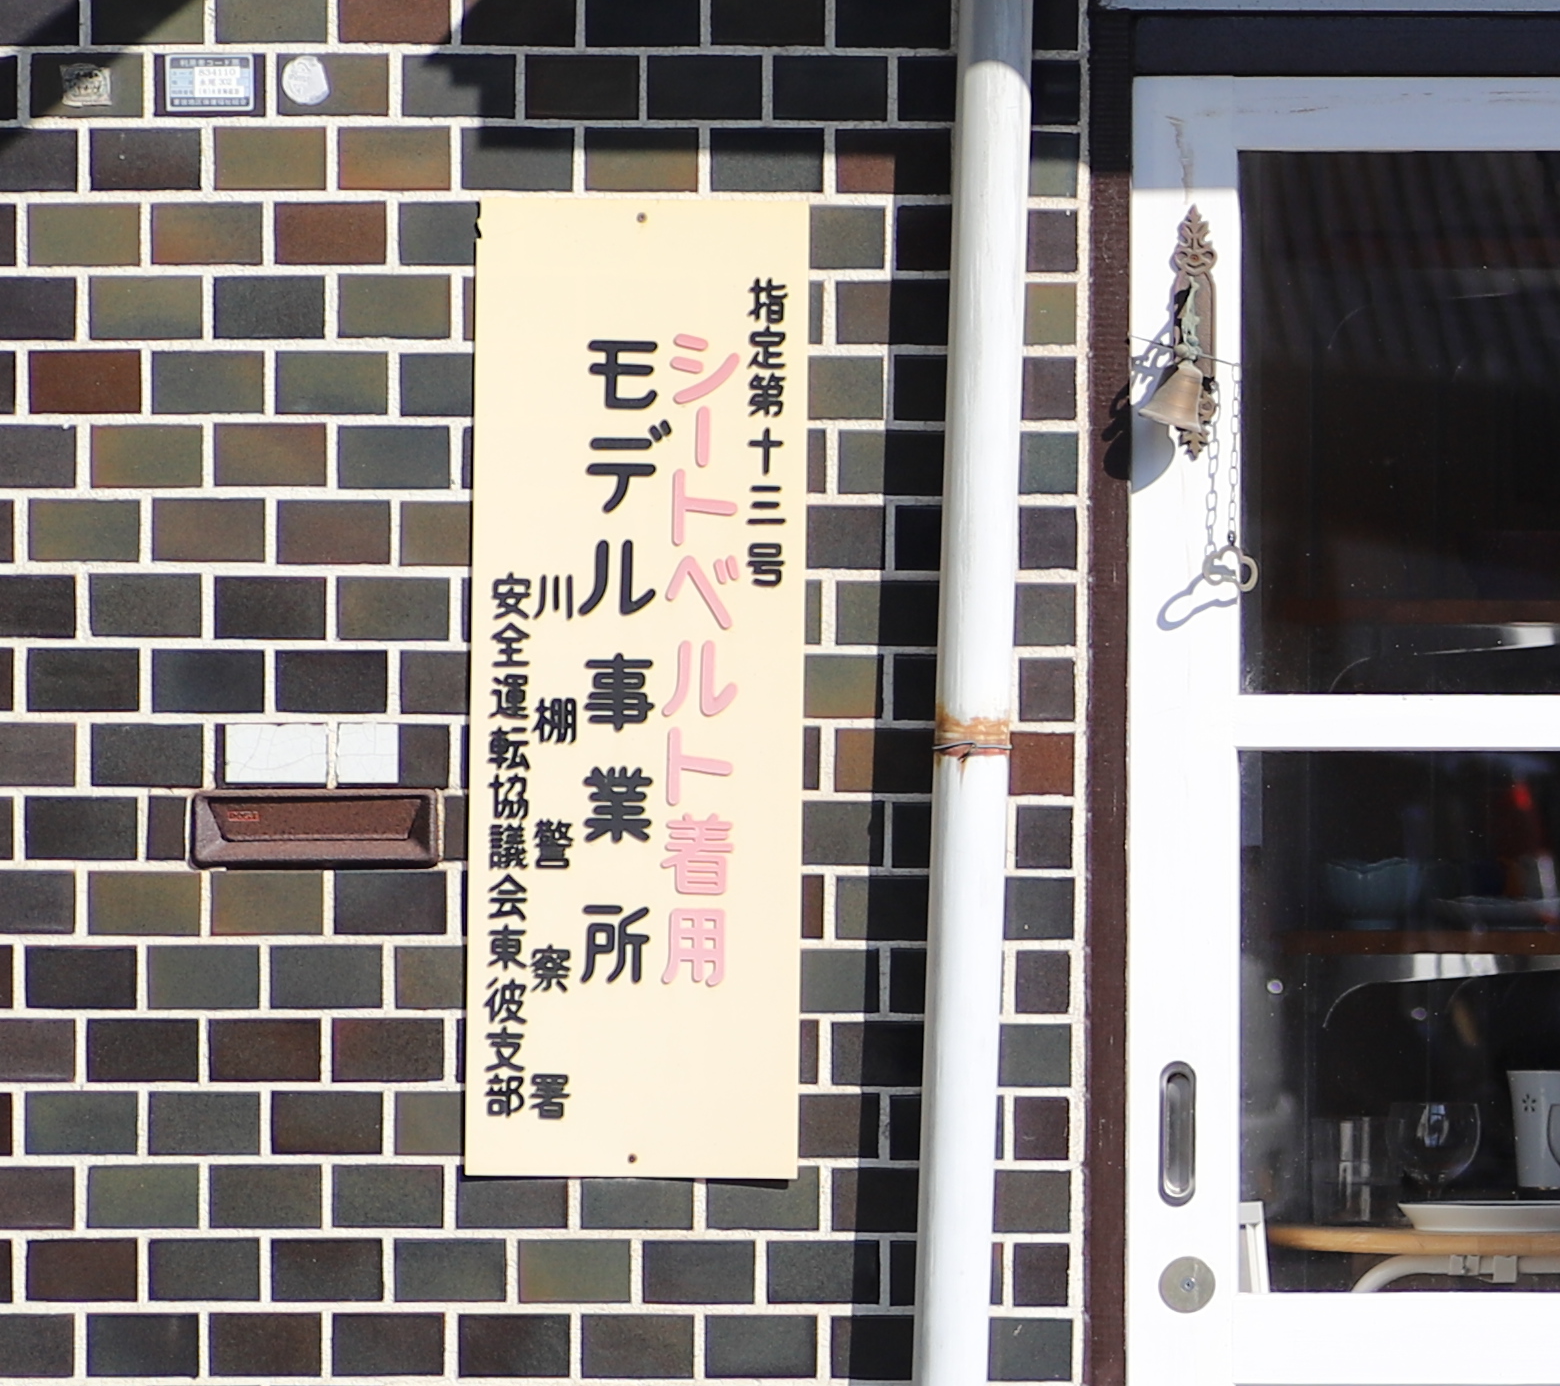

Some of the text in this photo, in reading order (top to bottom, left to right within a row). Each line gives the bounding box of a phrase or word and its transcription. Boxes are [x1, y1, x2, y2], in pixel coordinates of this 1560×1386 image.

[577, 339, 672, 985] モデル事業所
[659, 333, 740, 988] シートベルト着用
[746, 277, 788, 588] 指定第十三号
[483, 572, 532, 1119] 安全運転協議会東彼支部
[529, 573, 578, 1121] 川棚警察署
